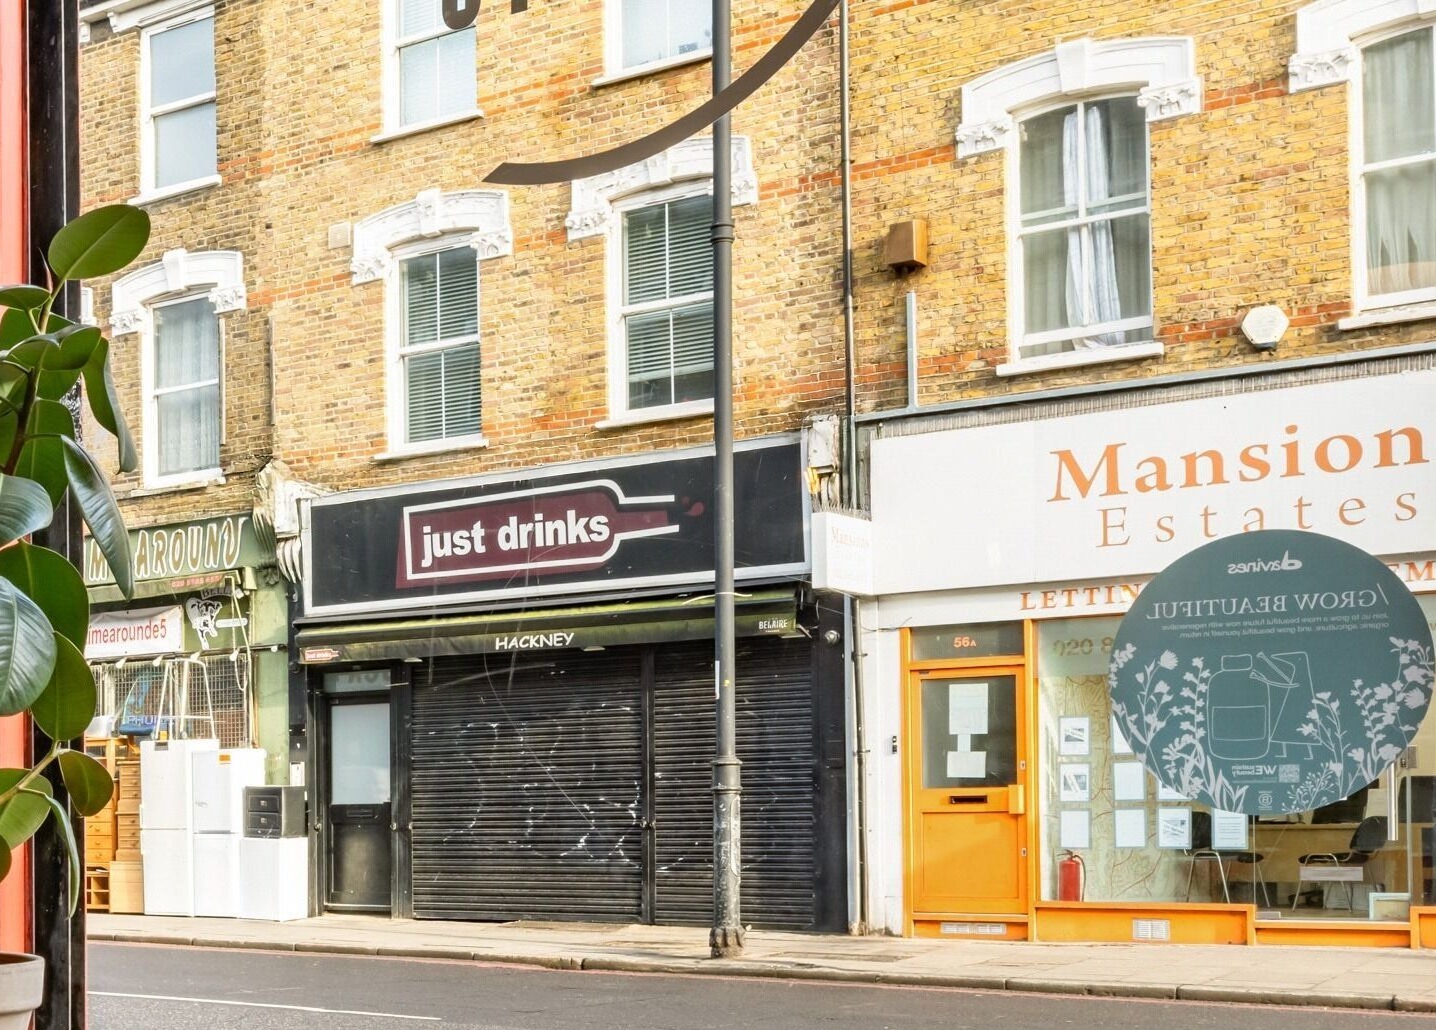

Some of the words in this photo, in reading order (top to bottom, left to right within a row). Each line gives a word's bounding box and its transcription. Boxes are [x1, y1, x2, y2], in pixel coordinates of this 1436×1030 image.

[1046, 424, 1430, 502] Mansion
[1096, 491, 1418, 548] Estates
[421, 519, 485, 567] just
[498, 509, 610, 550] drinks
[1020, 583, 1142, 610] LETTIN
[88, 618, 167, 645] imearounde5
[758, 619, 789, 630] BELAIRE
[495, 632, 574, 651] HACKNEY
[953, 636, 977, 648] 56A
